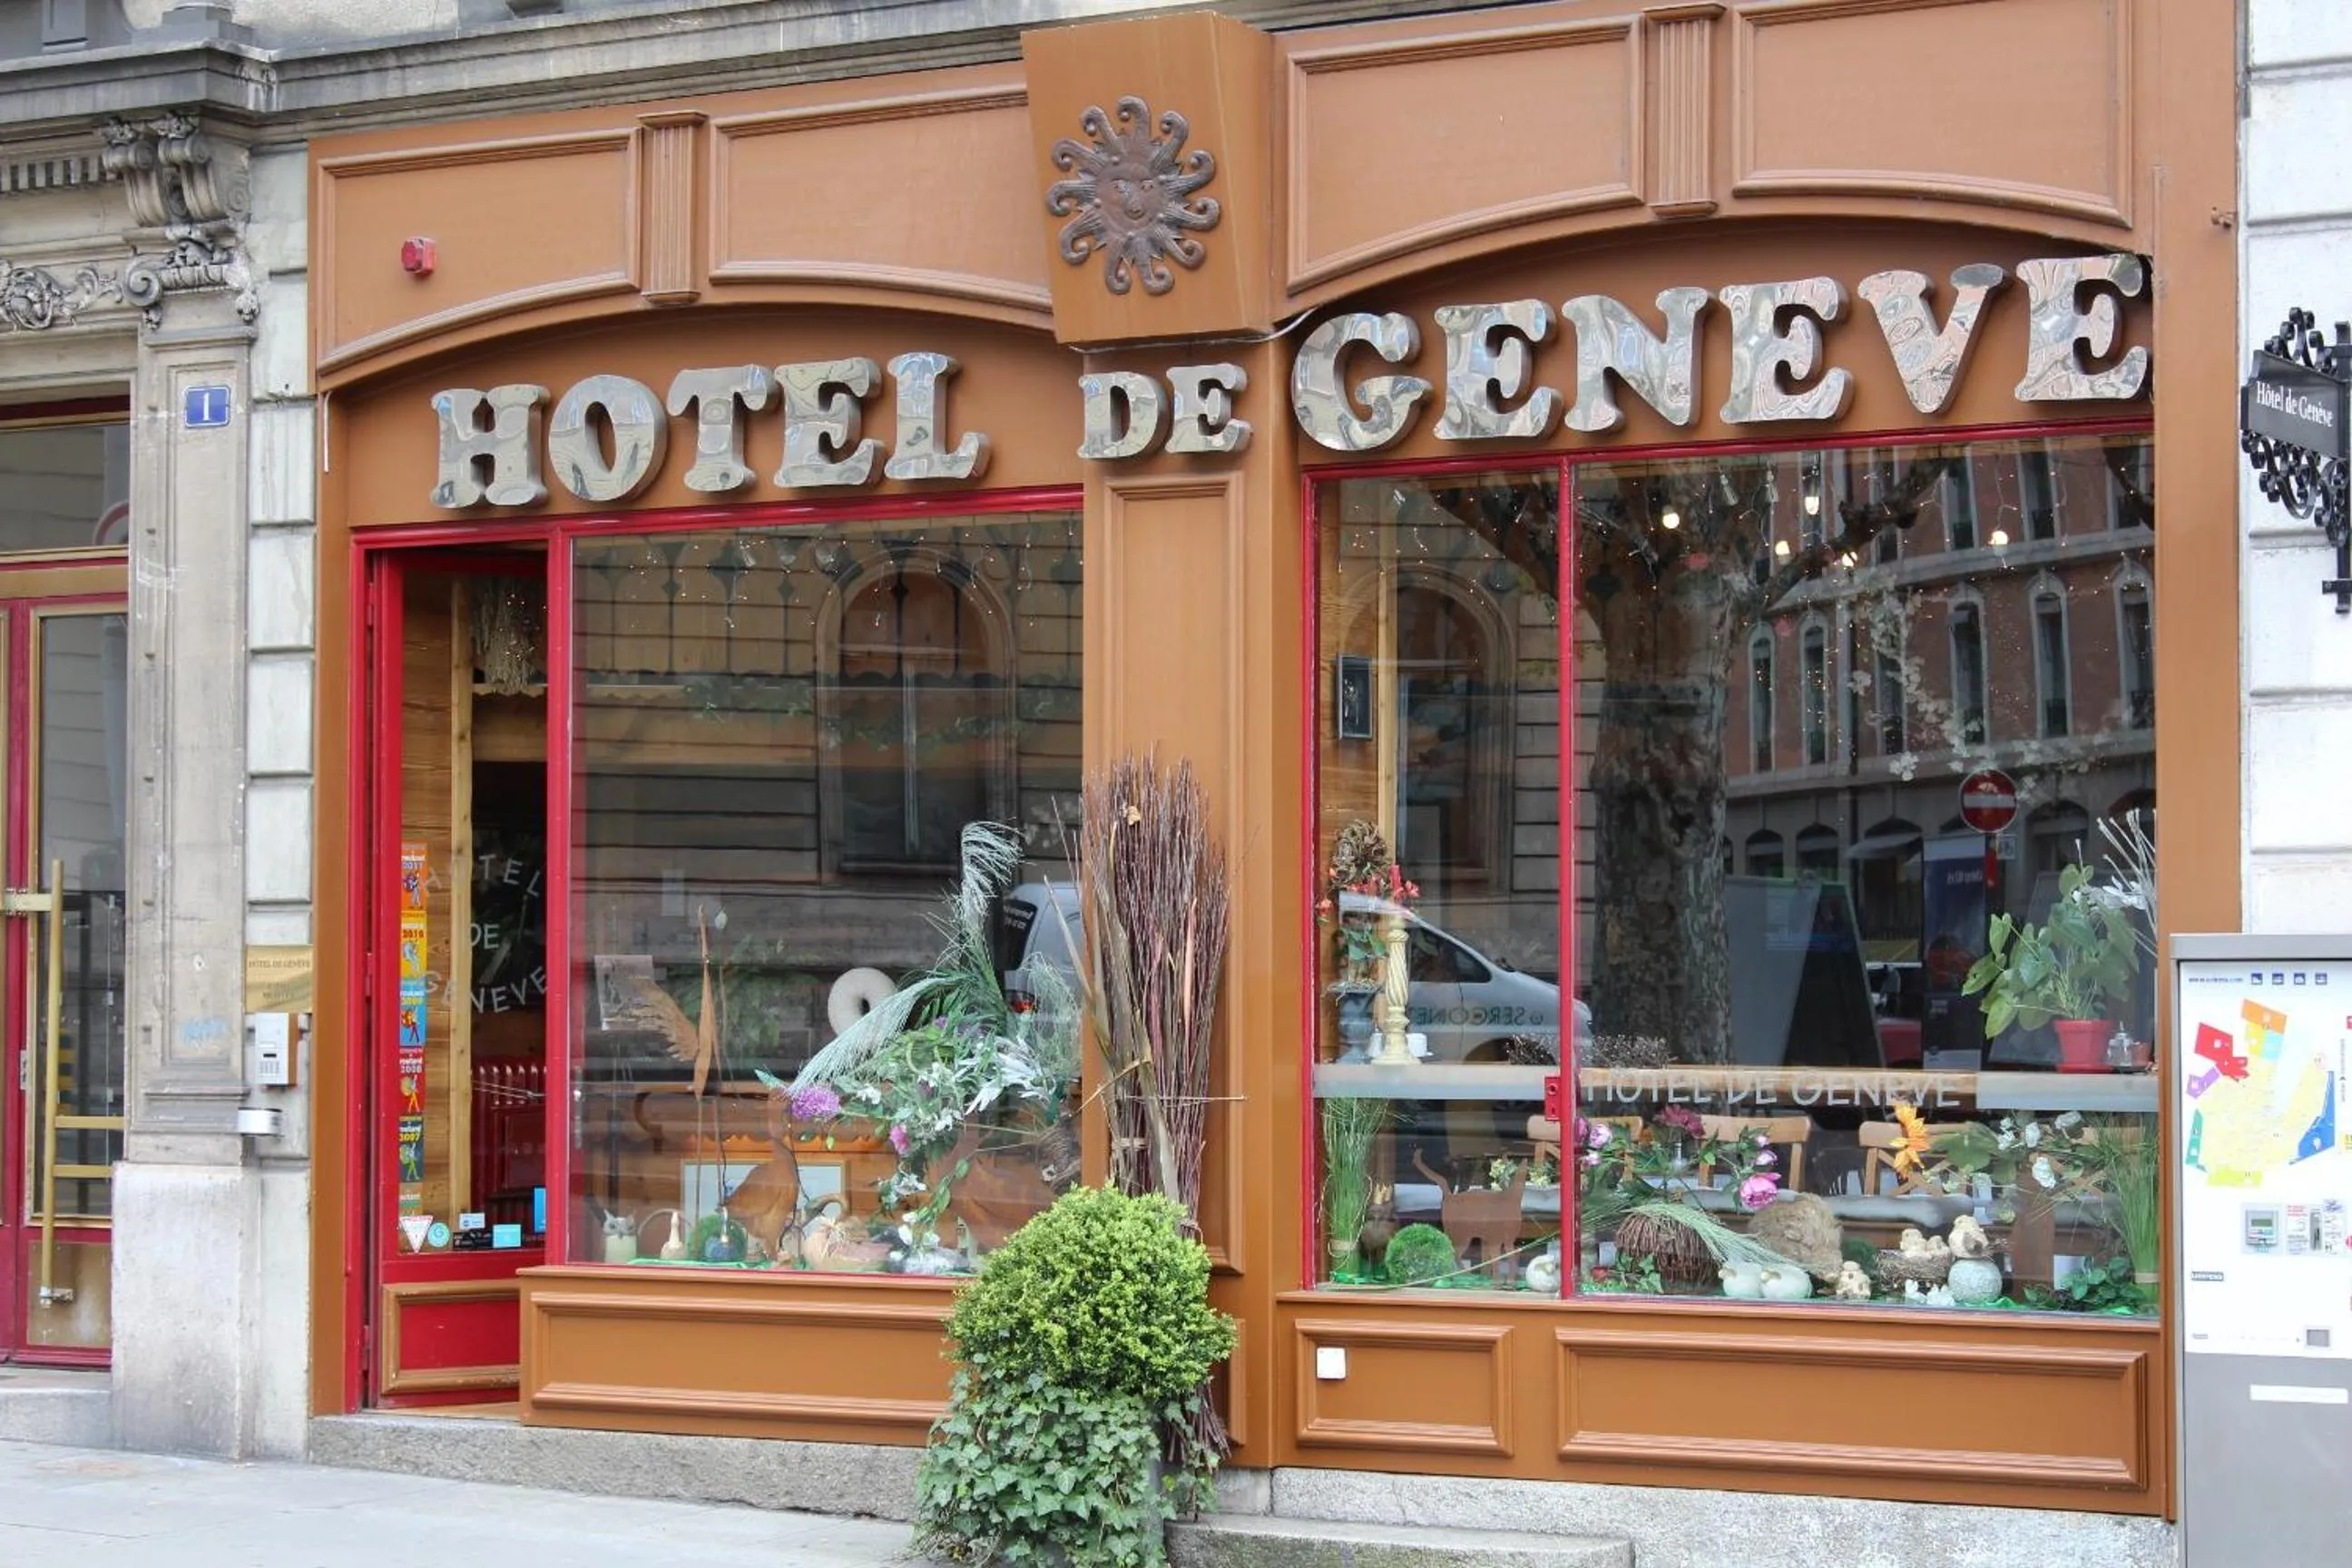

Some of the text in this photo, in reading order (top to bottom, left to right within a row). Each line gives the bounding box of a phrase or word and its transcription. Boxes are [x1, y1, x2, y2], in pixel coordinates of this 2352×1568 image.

[430, 253, 2150, 509] HOTEL DE GENEVE
[202, 391, 212, 422] 1
[2256, 380, 2334, 427] Hôtel de Genève
[1727, 1073, 1778, 1104] DE
